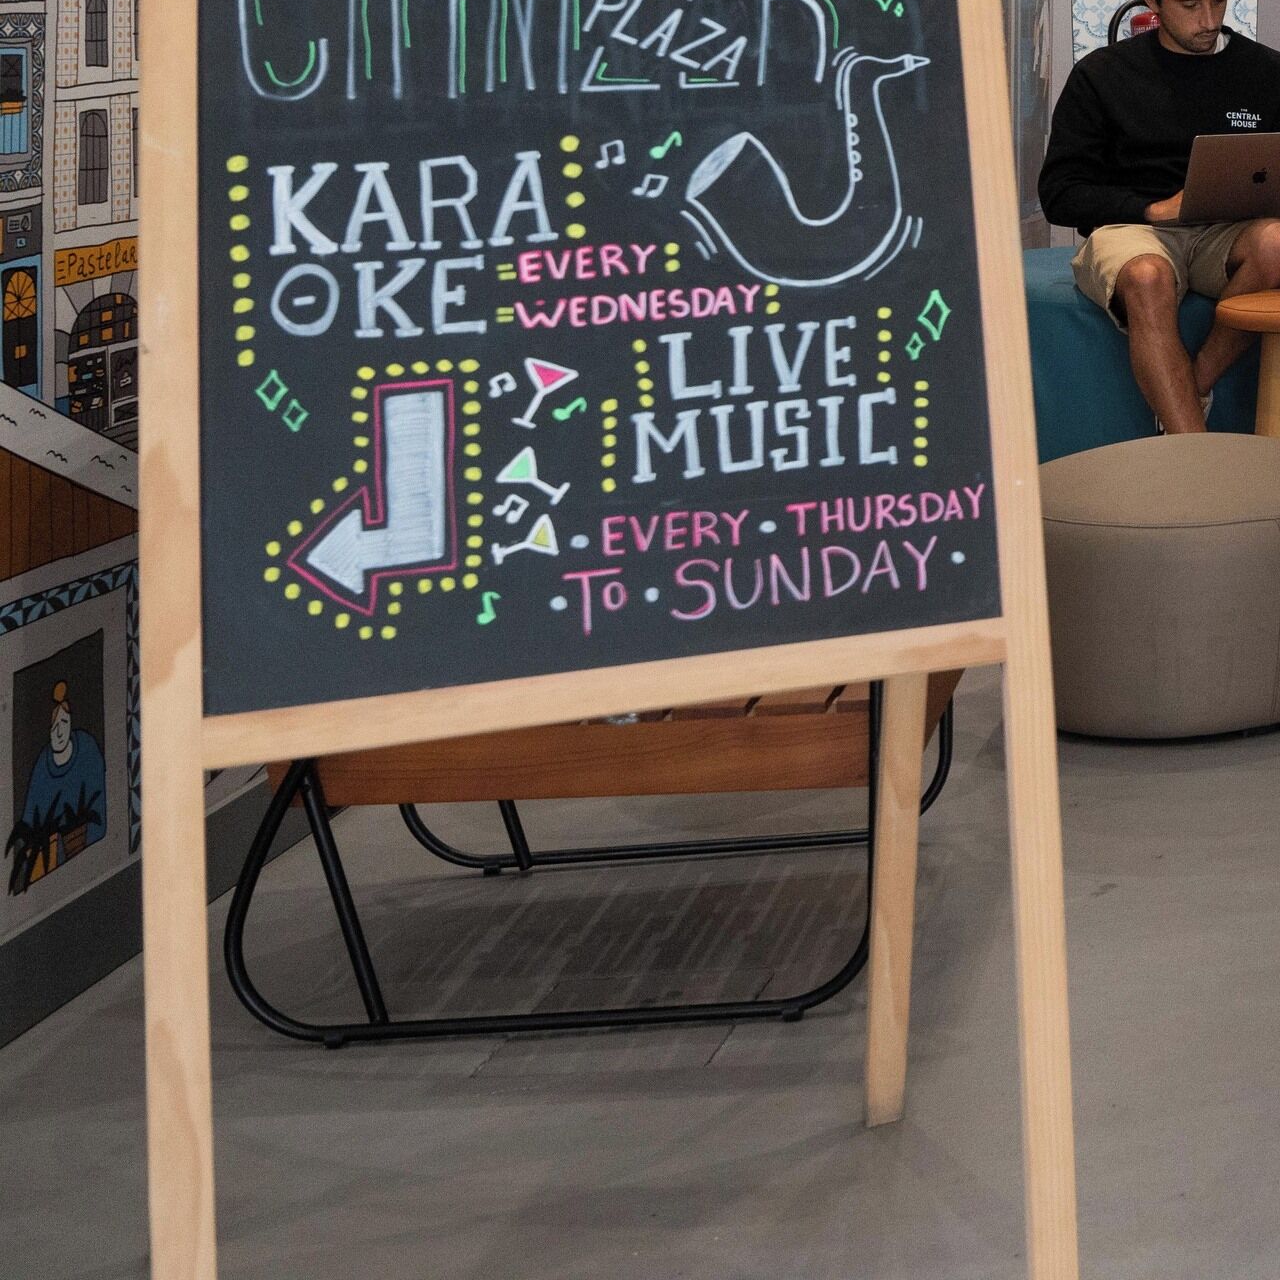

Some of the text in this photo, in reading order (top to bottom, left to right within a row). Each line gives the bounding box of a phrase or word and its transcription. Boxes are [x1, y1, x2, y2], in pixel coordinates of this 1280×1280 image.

[1226, 111, 1262, 121] CENTRAL
[1231, 120, 1257, 129] HOUSE
[267, 150, 559, 256] KARA
[270, 254, 487, 339] OKE
[517, 243, 657, 285] EVERY
[513, 284, 761, 329] WEDNESDAY
[658, 316, 857, 401] LIVE
[631, 387, 899, 484] MUSIC
[602, 483, 985, 557] EVERY THURSDAY
[562, 535, 938, 637] To SUNDAY
